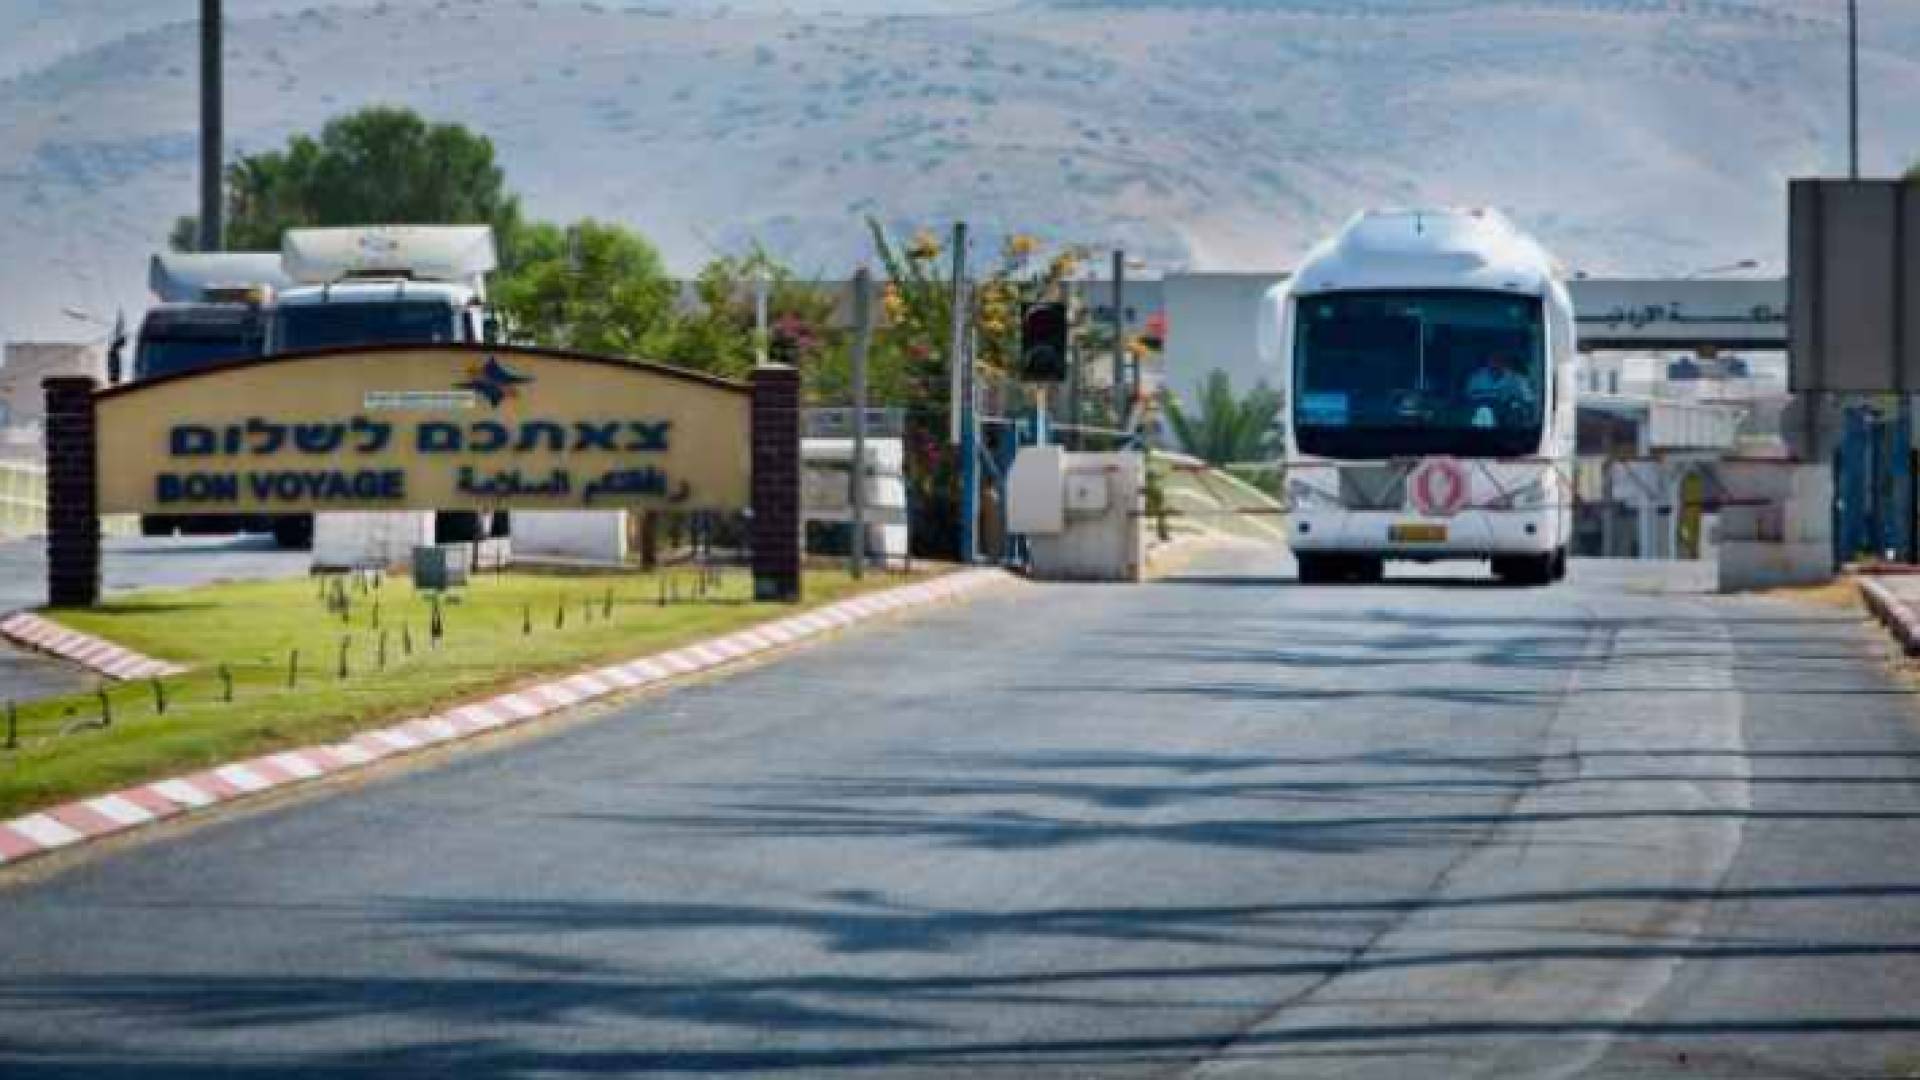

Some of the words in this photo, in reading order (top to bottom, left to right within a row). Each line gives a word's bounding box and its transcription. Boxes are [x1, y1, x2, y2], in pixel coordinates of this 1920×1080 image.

[170, 415, 393, 455] לשלום
[416, 419, 673, 454] צאתכם
[157, 472, 239, 501] BON
[250, 469, 406, 499] VOYAGE
